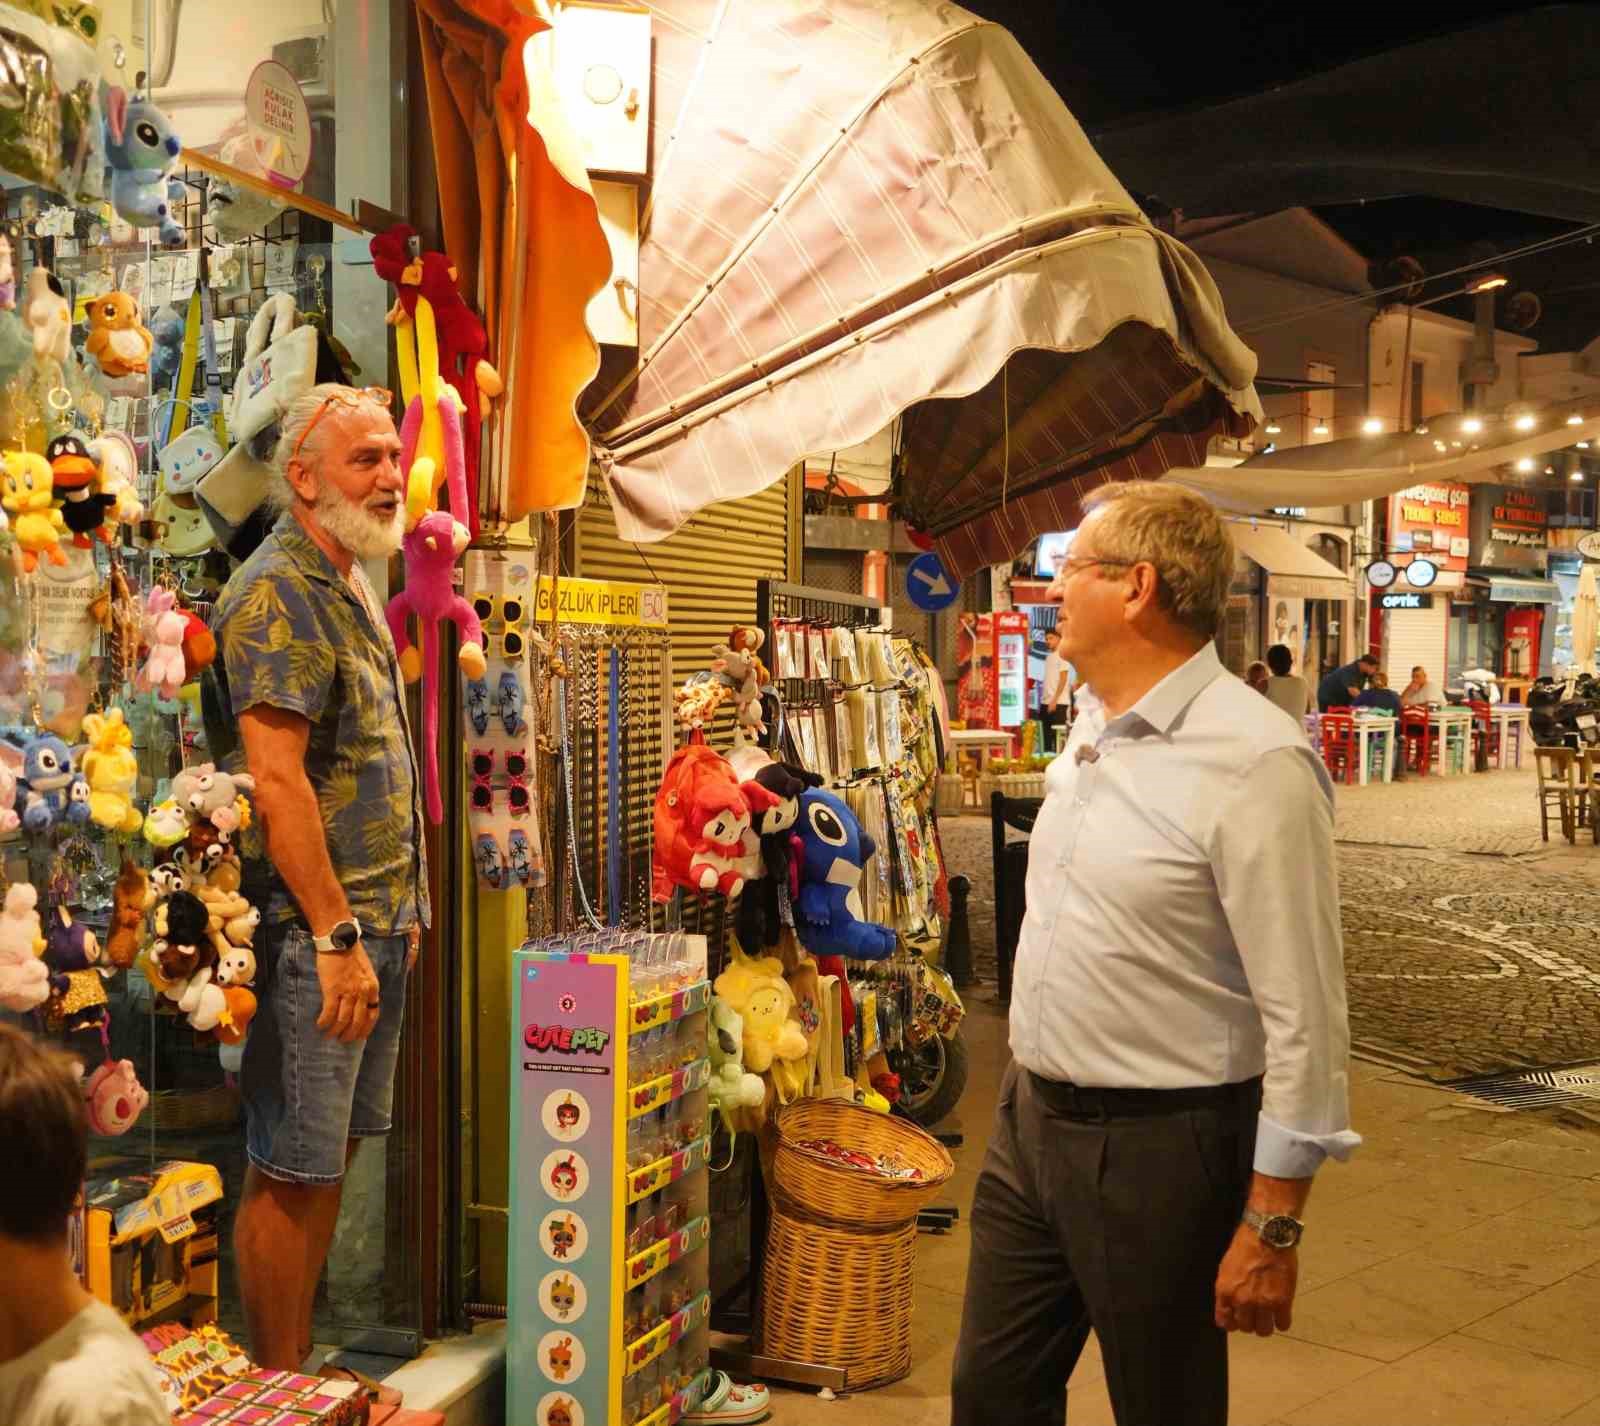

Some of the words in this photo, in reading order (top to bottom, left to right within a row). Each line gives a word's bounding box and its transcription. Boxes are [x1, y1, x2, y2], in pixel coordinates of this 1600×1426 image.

[538, 587, 594, 614] GZLÜK
[598, 588, 639, 617] İPLERİ
[643, 591, 663, 619] 50
[1382, 592, 1420, 608] OPTİK
